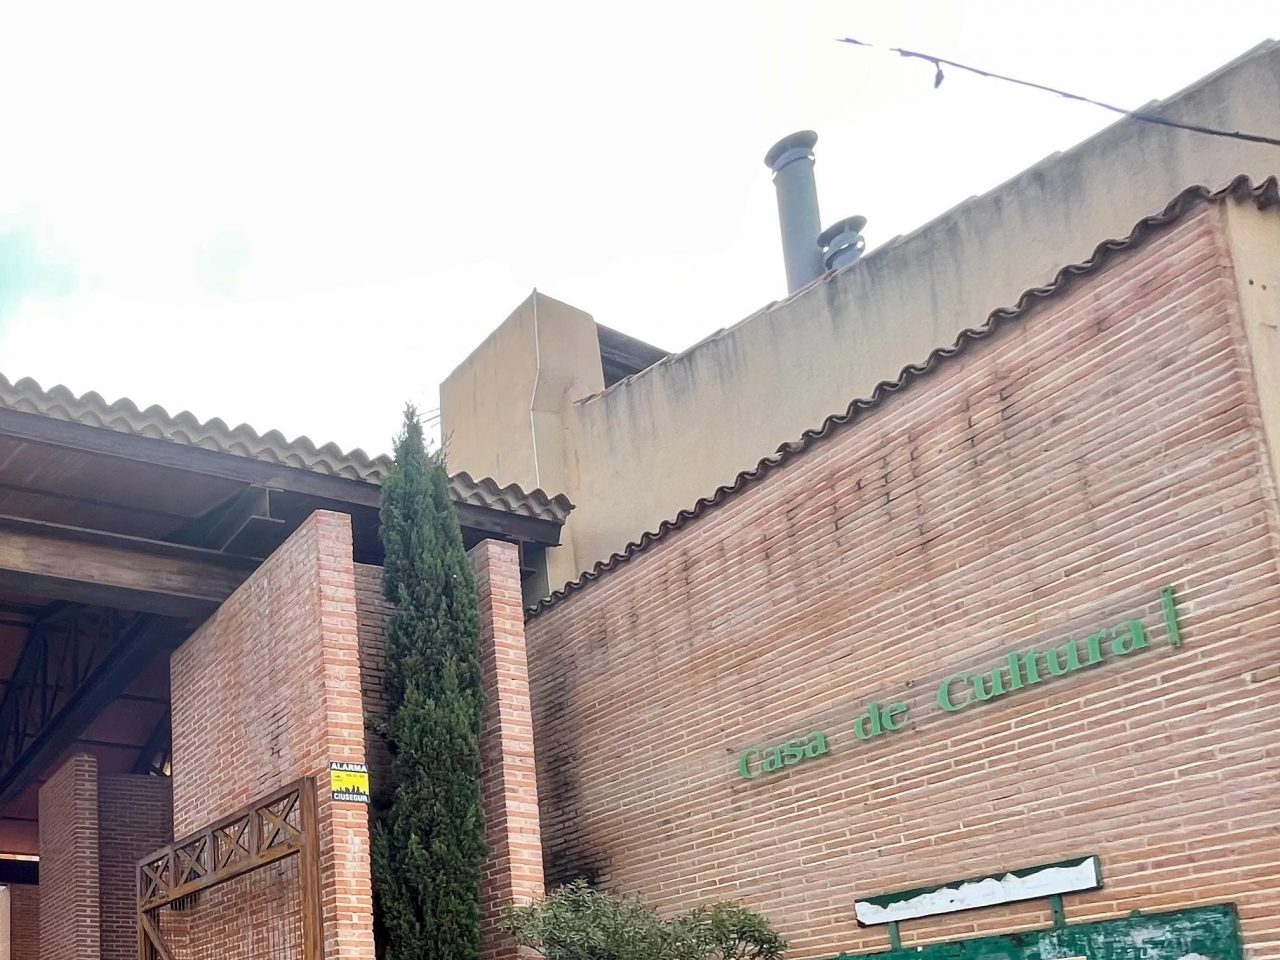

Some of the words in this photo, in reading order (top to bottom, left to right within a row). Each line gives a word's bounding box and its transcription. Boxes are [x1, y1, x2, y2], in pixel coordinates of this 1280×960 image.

[737, 728, 830, 780] Casa
[852, 701, 909, 741] de
[331, 762, 368, 773] ALARMA
